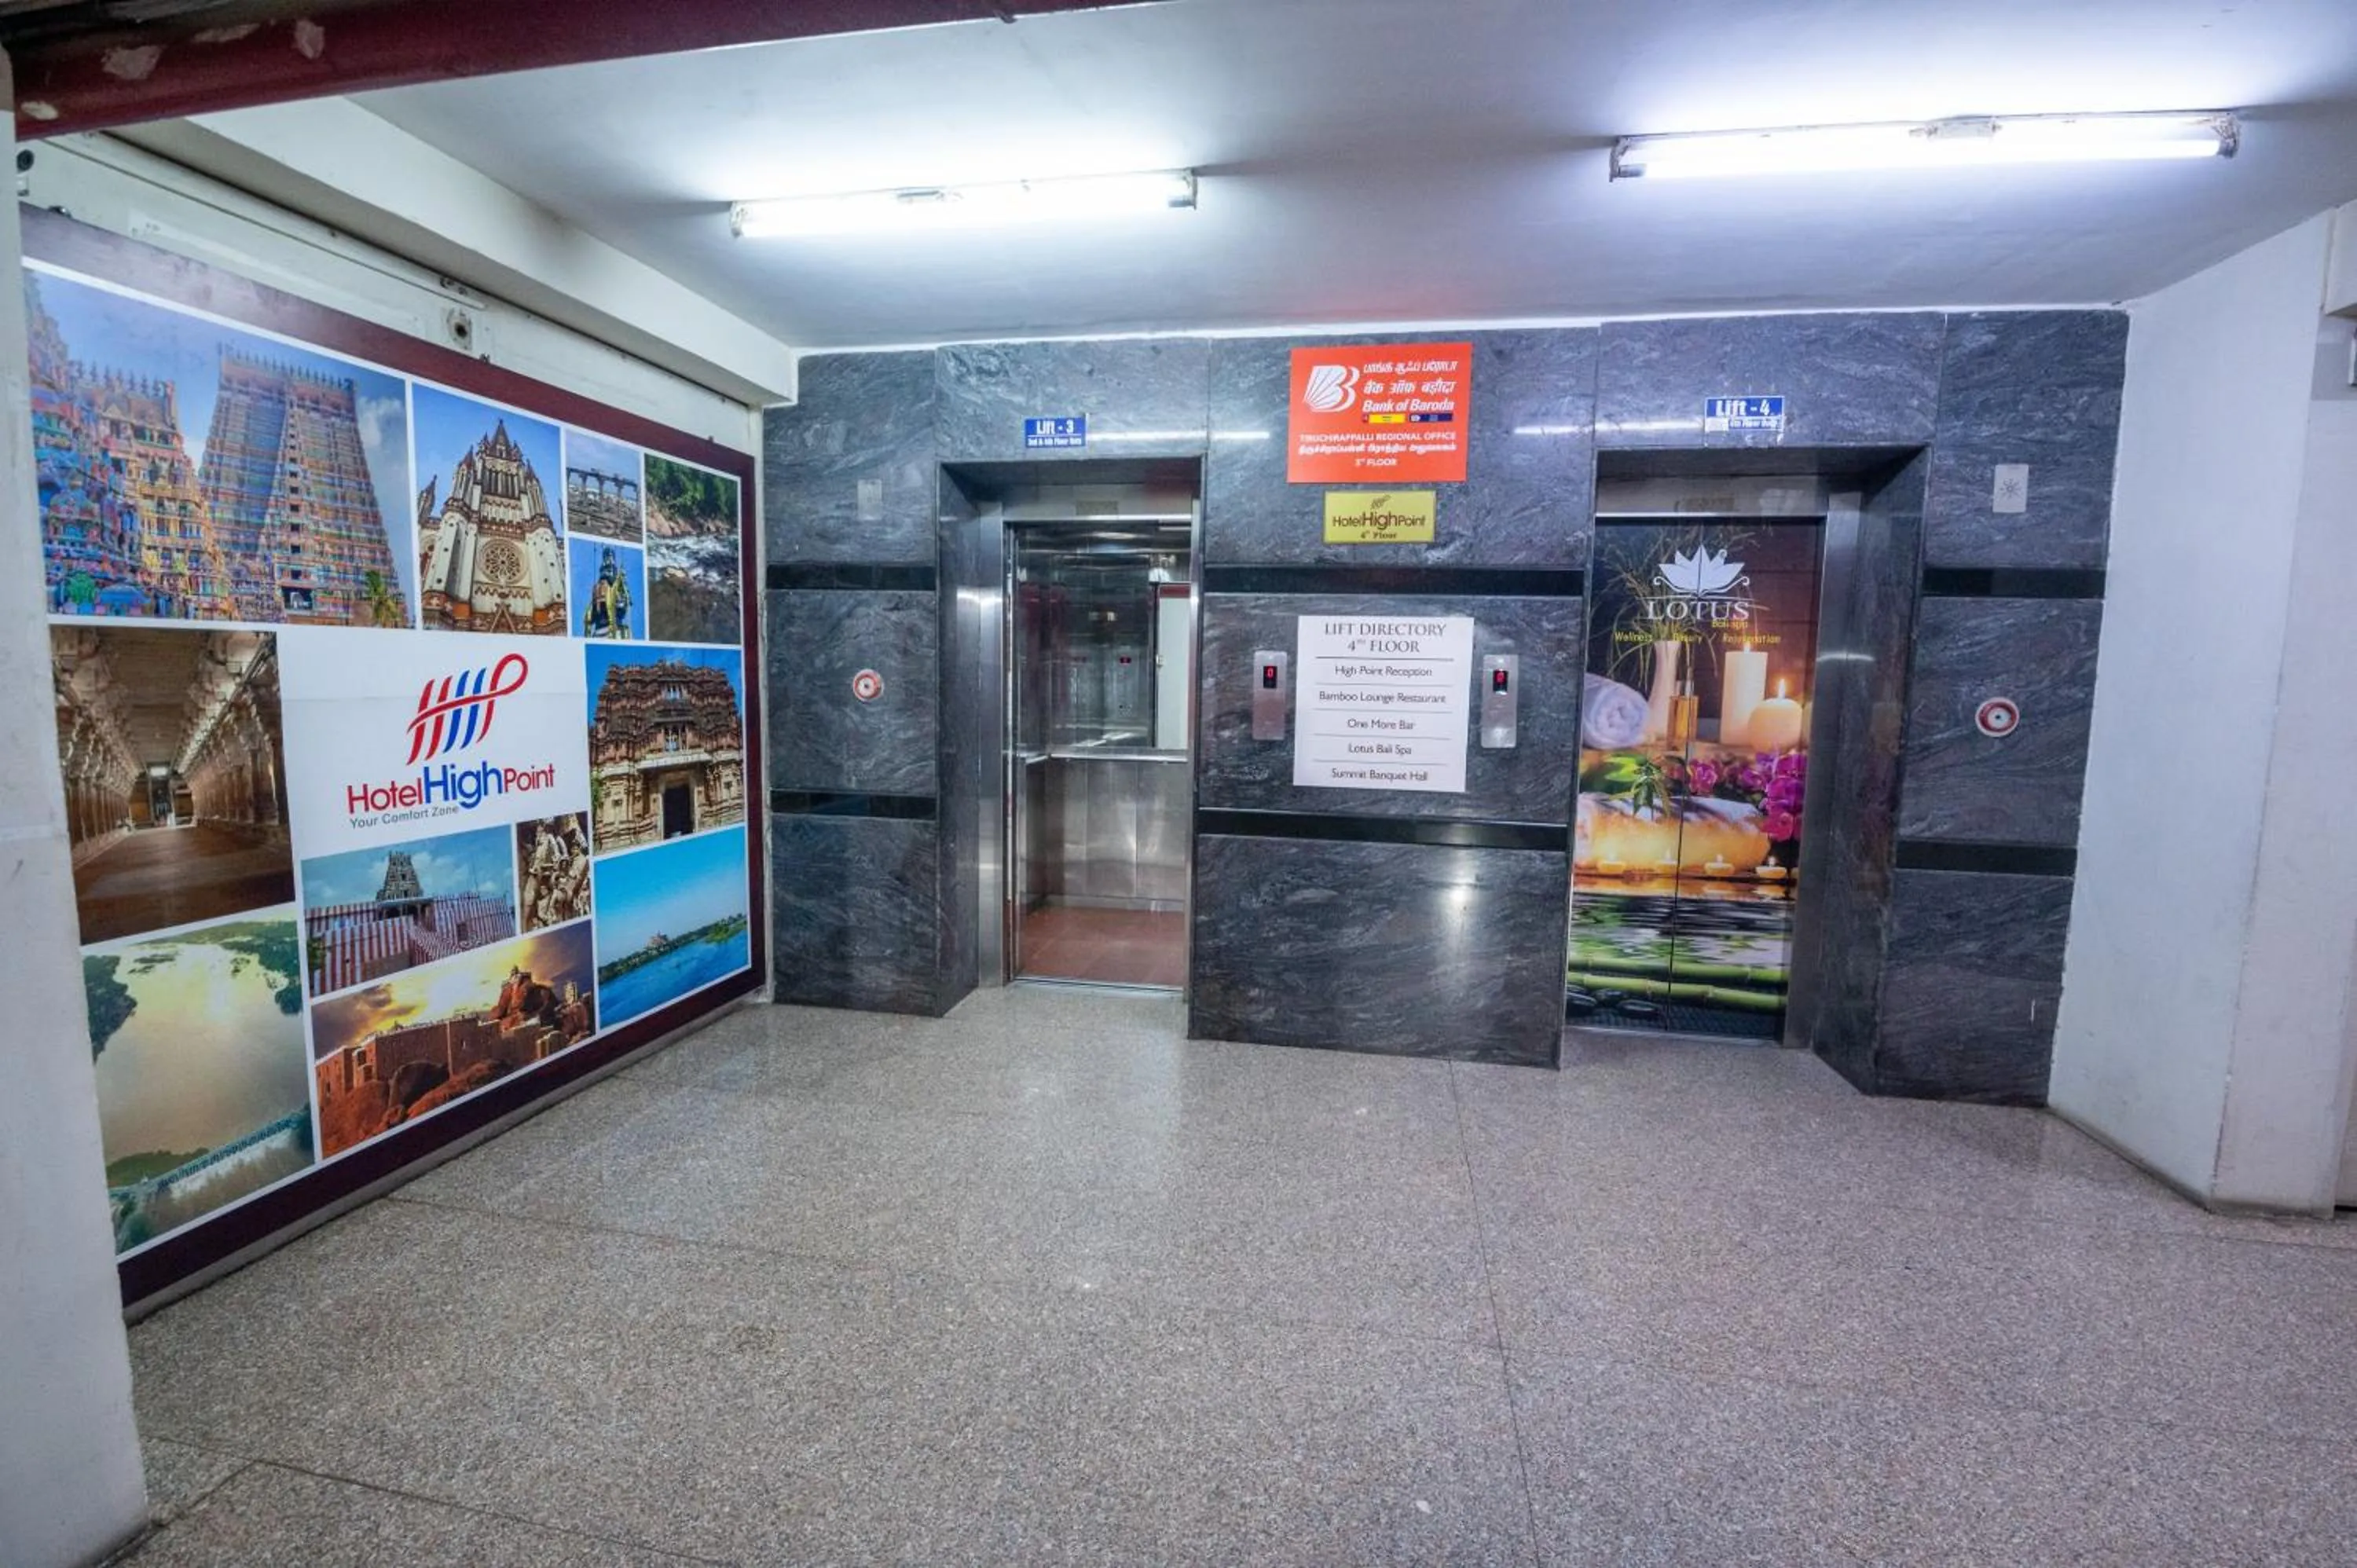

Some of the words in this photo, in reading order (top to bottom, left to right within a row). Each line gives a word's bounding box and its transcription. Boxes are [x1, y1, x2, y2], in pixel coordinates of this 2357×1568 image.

[1362, 399, 1395, 412] Bank
[1395, 398, 1409, 412] of
[1409, 397, 1455, 412] Baroda
[1716, 399, 1747, 416] Lift
[1760, 399, 1770, 416] 4
[1036, 419, 1055, 434] Lift
[1066, 419, 1074, 434] 3
[1376, 432, 1422, 441] REGIONAL
[1424, 430, 1457, 441] OFFICE
[1373, 530, 1397, 539] Floor
[1647, 600, 1750, 621] LOTUS
[1325, 622, 1355, 636] LIFT
[1359, 622, 1447, 637] DIRECTORY
[1615, 631, 1654, 643] Wellness
[1370, 639, 1420, 654] FLOOR
[1335, 666, 1357, 676] High
[1359, 666, 1384, 676] Point
[1385, 666, 1432, 678] Reception
[1319, 691, 1357, 702] Bamboo
[1360, 692, 1395, 704] Lounge
[1397, 694, 1446, 704] Restaurant
[1347, 719, 1369, 729] One
[1371, 720, 1397, 730] More
[1398, 720, 1415, 730] Bar
[1348, 744, 1374, 754] Lotus
[1376, 744, 1394, 754] Bali
[1395, 745, 1412, 756] Spa
[1332, 768, 1366, 779] Summit
[1369, 769, 1408, 782] Banquet
[1410, 771, 1428, 781] Hall
[350, 815, 379, 830] Your
[381, 809, 429, 825] Comfort
[431, 806, 460, 819] Zone
